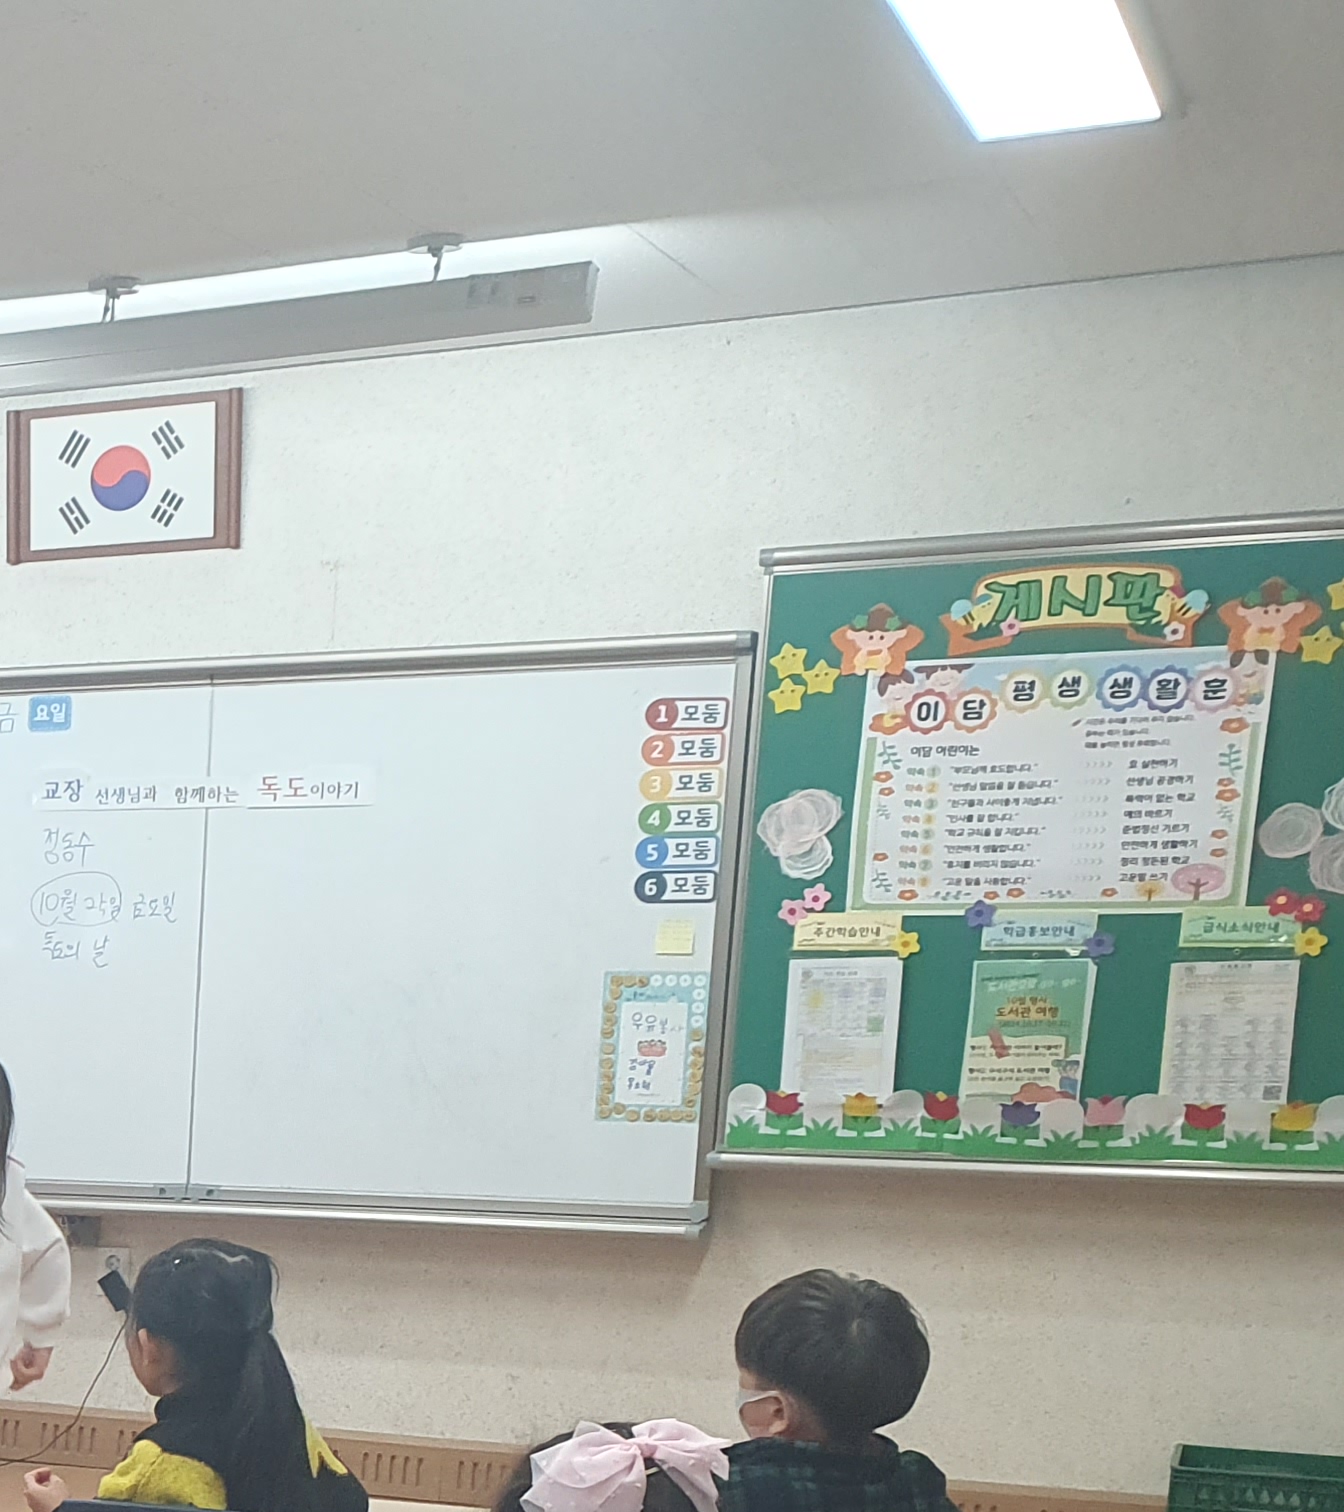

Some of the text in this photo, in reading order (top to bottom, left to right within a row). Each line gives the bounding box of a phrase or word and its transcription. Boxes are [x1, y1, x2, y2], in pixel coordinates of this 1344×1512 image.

[985, 571, 1165, 622] 게시판
[916, 676, 1228, 722] 이담 평생 생활훈
[34, 704, 67, 723] 요일
[655, 704, 721, 724] 1 모둠
[650, 738, 717, 758] 2 모둠
[41, 779, 84, 803] 교장
[95, 785, 157, 805] 선생님과
[175, 785, 239, 804] 함께하는
[650, 773, 715, 793] 3 모둠
[647, 808, 713, 828] 4 모둠
[646, 841, 711, 861] 5 모둠
[644, 876, 710, 896] 6 모둠
